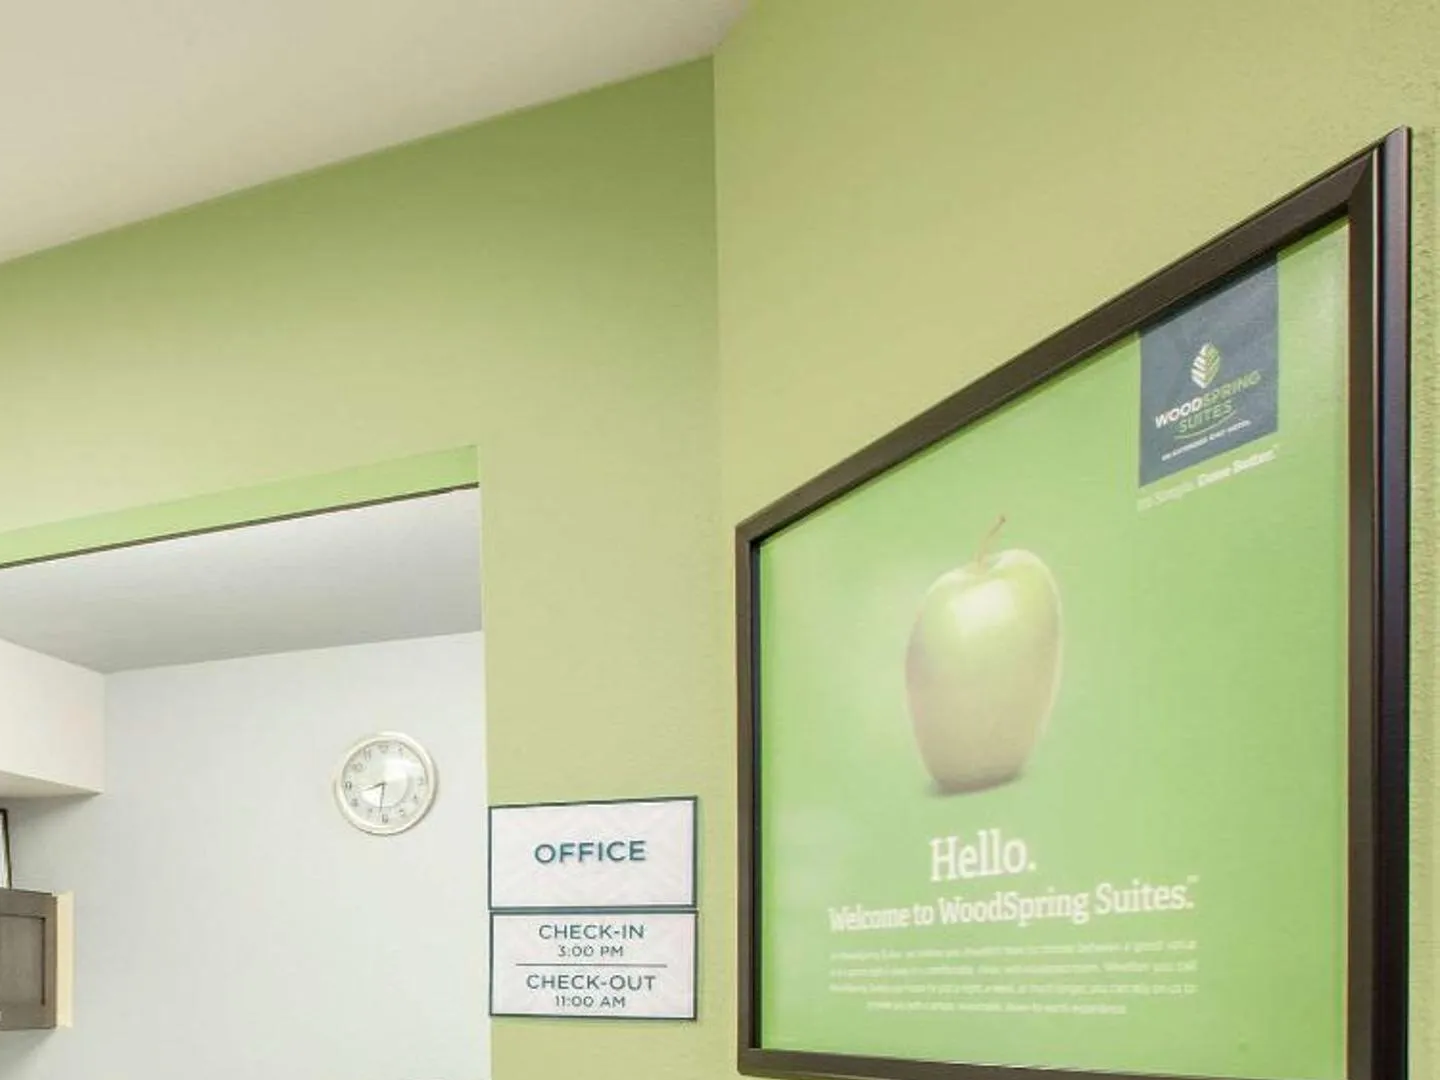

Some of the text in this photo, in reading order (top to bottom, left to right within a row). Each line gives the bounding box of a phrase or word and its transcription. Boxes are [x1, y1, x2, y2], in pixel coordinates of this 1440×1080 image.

[534, 840, 646, 863] OFFICE
[929, 828, 1036, 882] Hello.
[828, 904, 911, 931] Welcome
[913, 903, 934, 925] to
[937, 886, 1090, 926] WoodSpring
[538, 924, 645, 940] CHECK-IN
[557, 945, 624, 957] 3:00 PM
[526, 974, 656, 991] CHECK-OUT
[555, 995, 626, 1008] 11:00 AM
